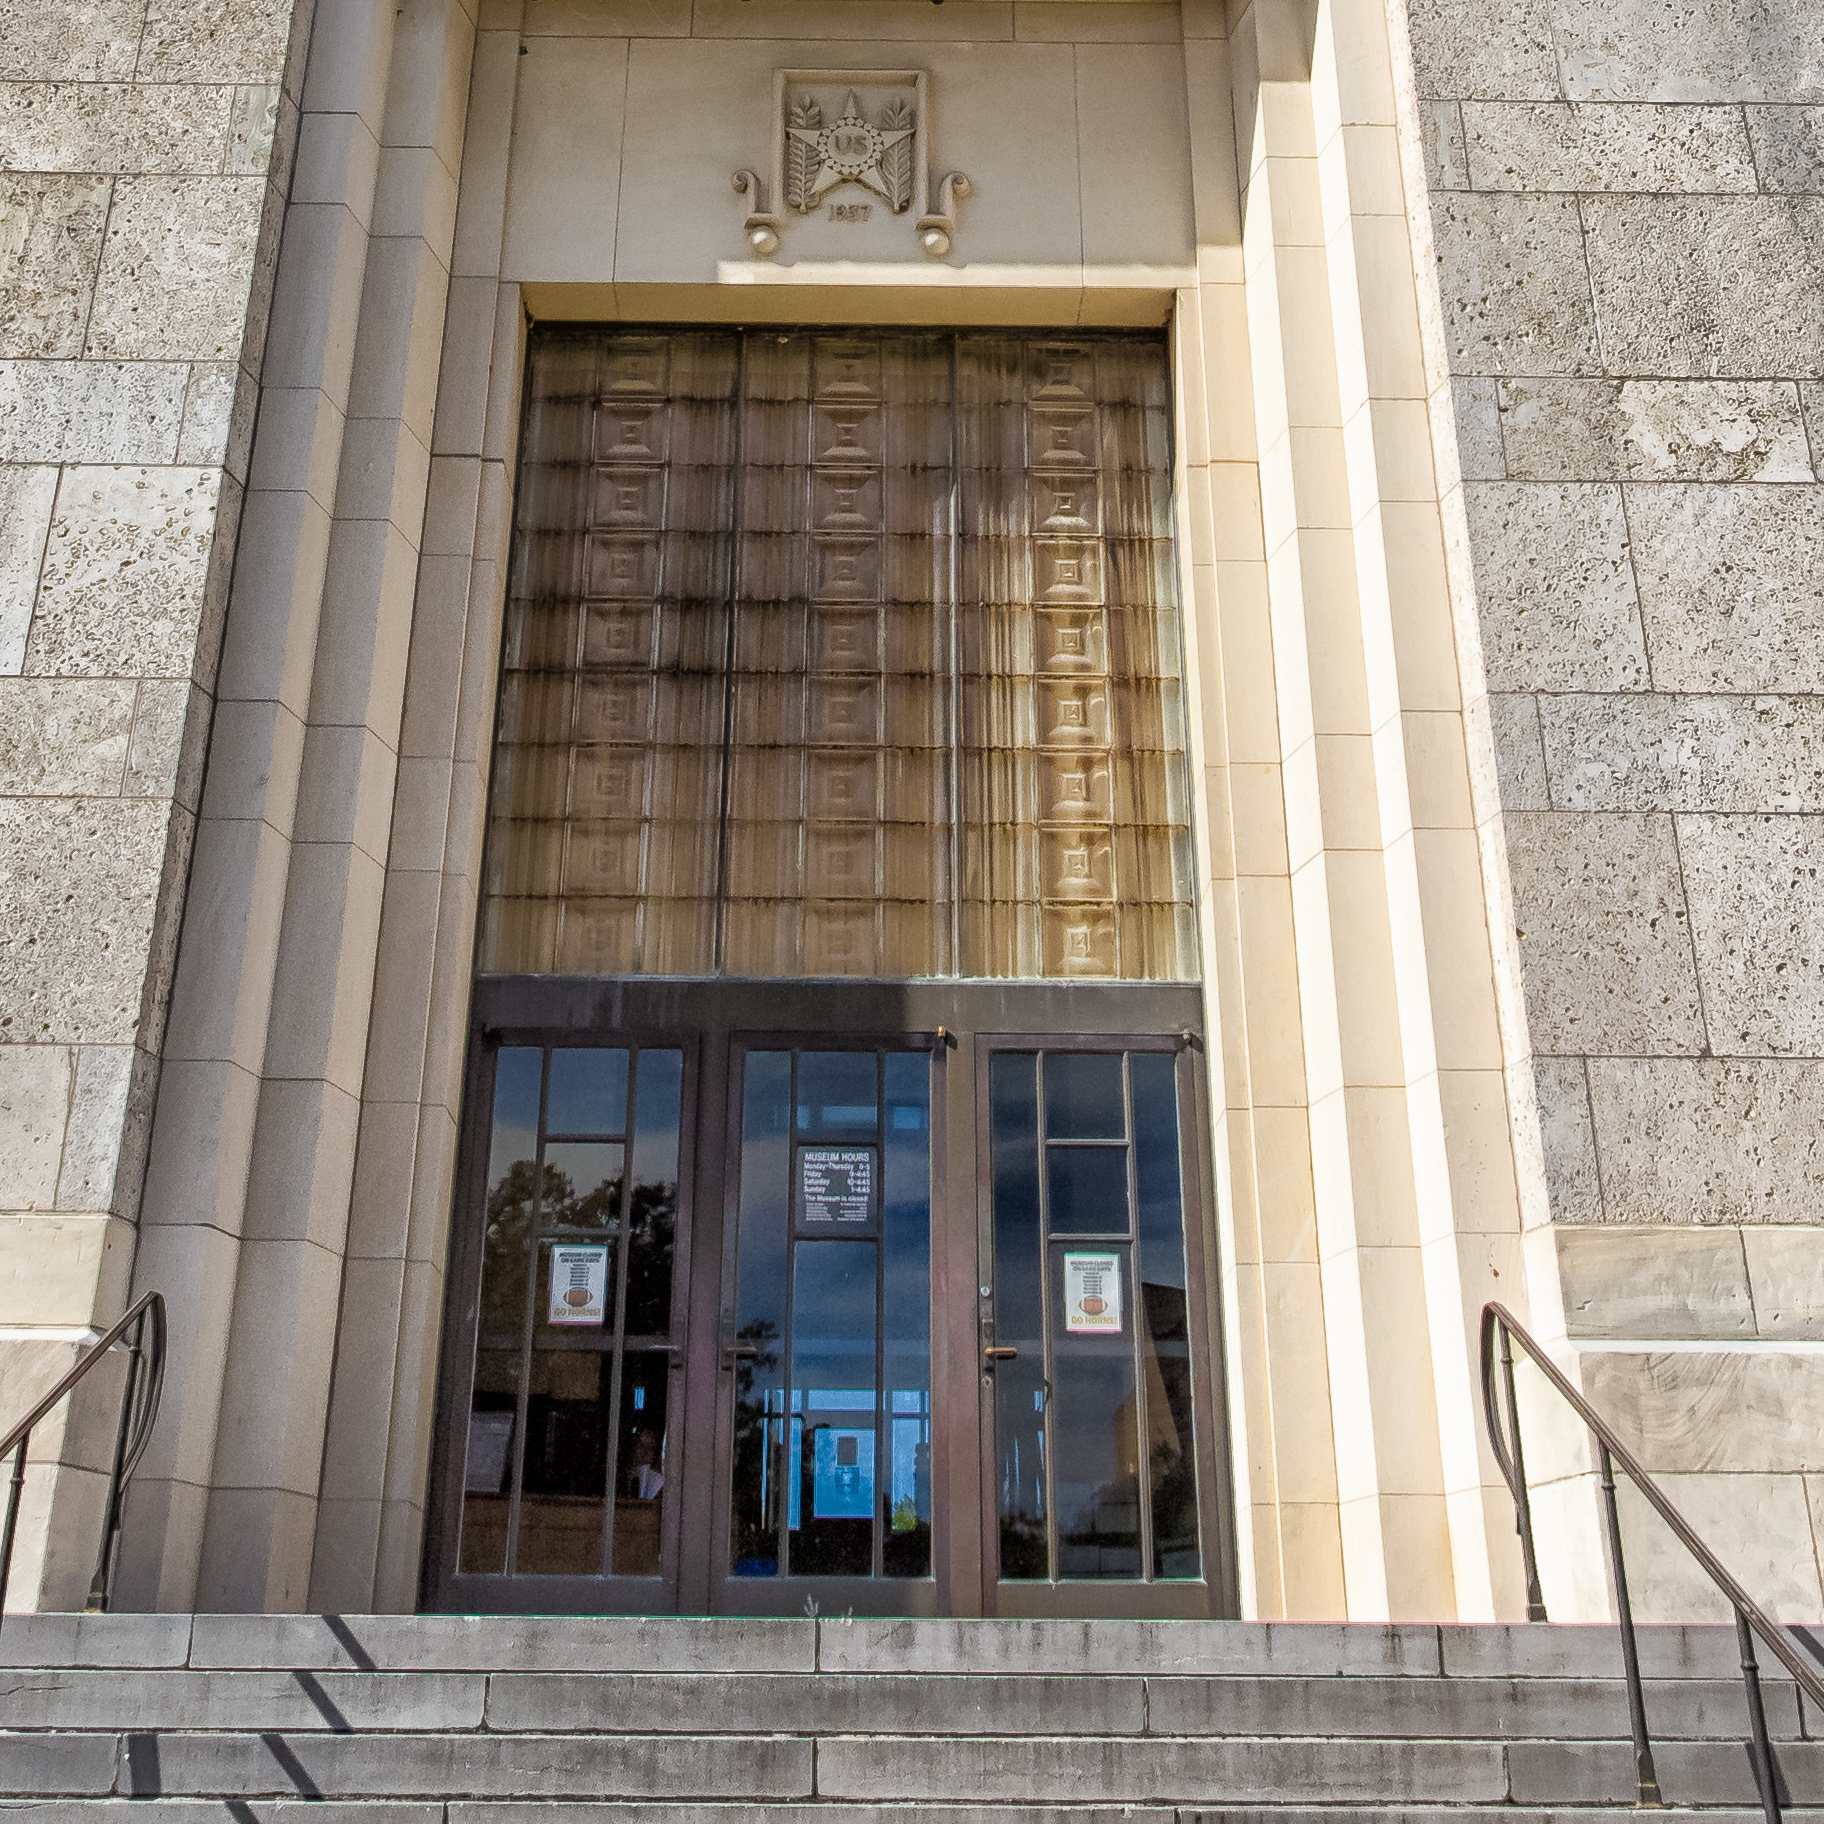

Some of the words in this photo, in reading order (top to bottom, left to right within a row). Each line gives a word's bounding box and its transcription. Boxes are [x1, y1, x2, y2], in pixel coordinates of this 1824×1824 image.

[834, 135, 868, 156] US
[804, 1151, 840, 1162] MUSEUM
[841, 1151, 870, 1163] HOURS
[803, 1170, 823, 1179] Friday
[803, 1178, 831, 1187] Saturday
[803, 1186, 827, 1194] Sunday
